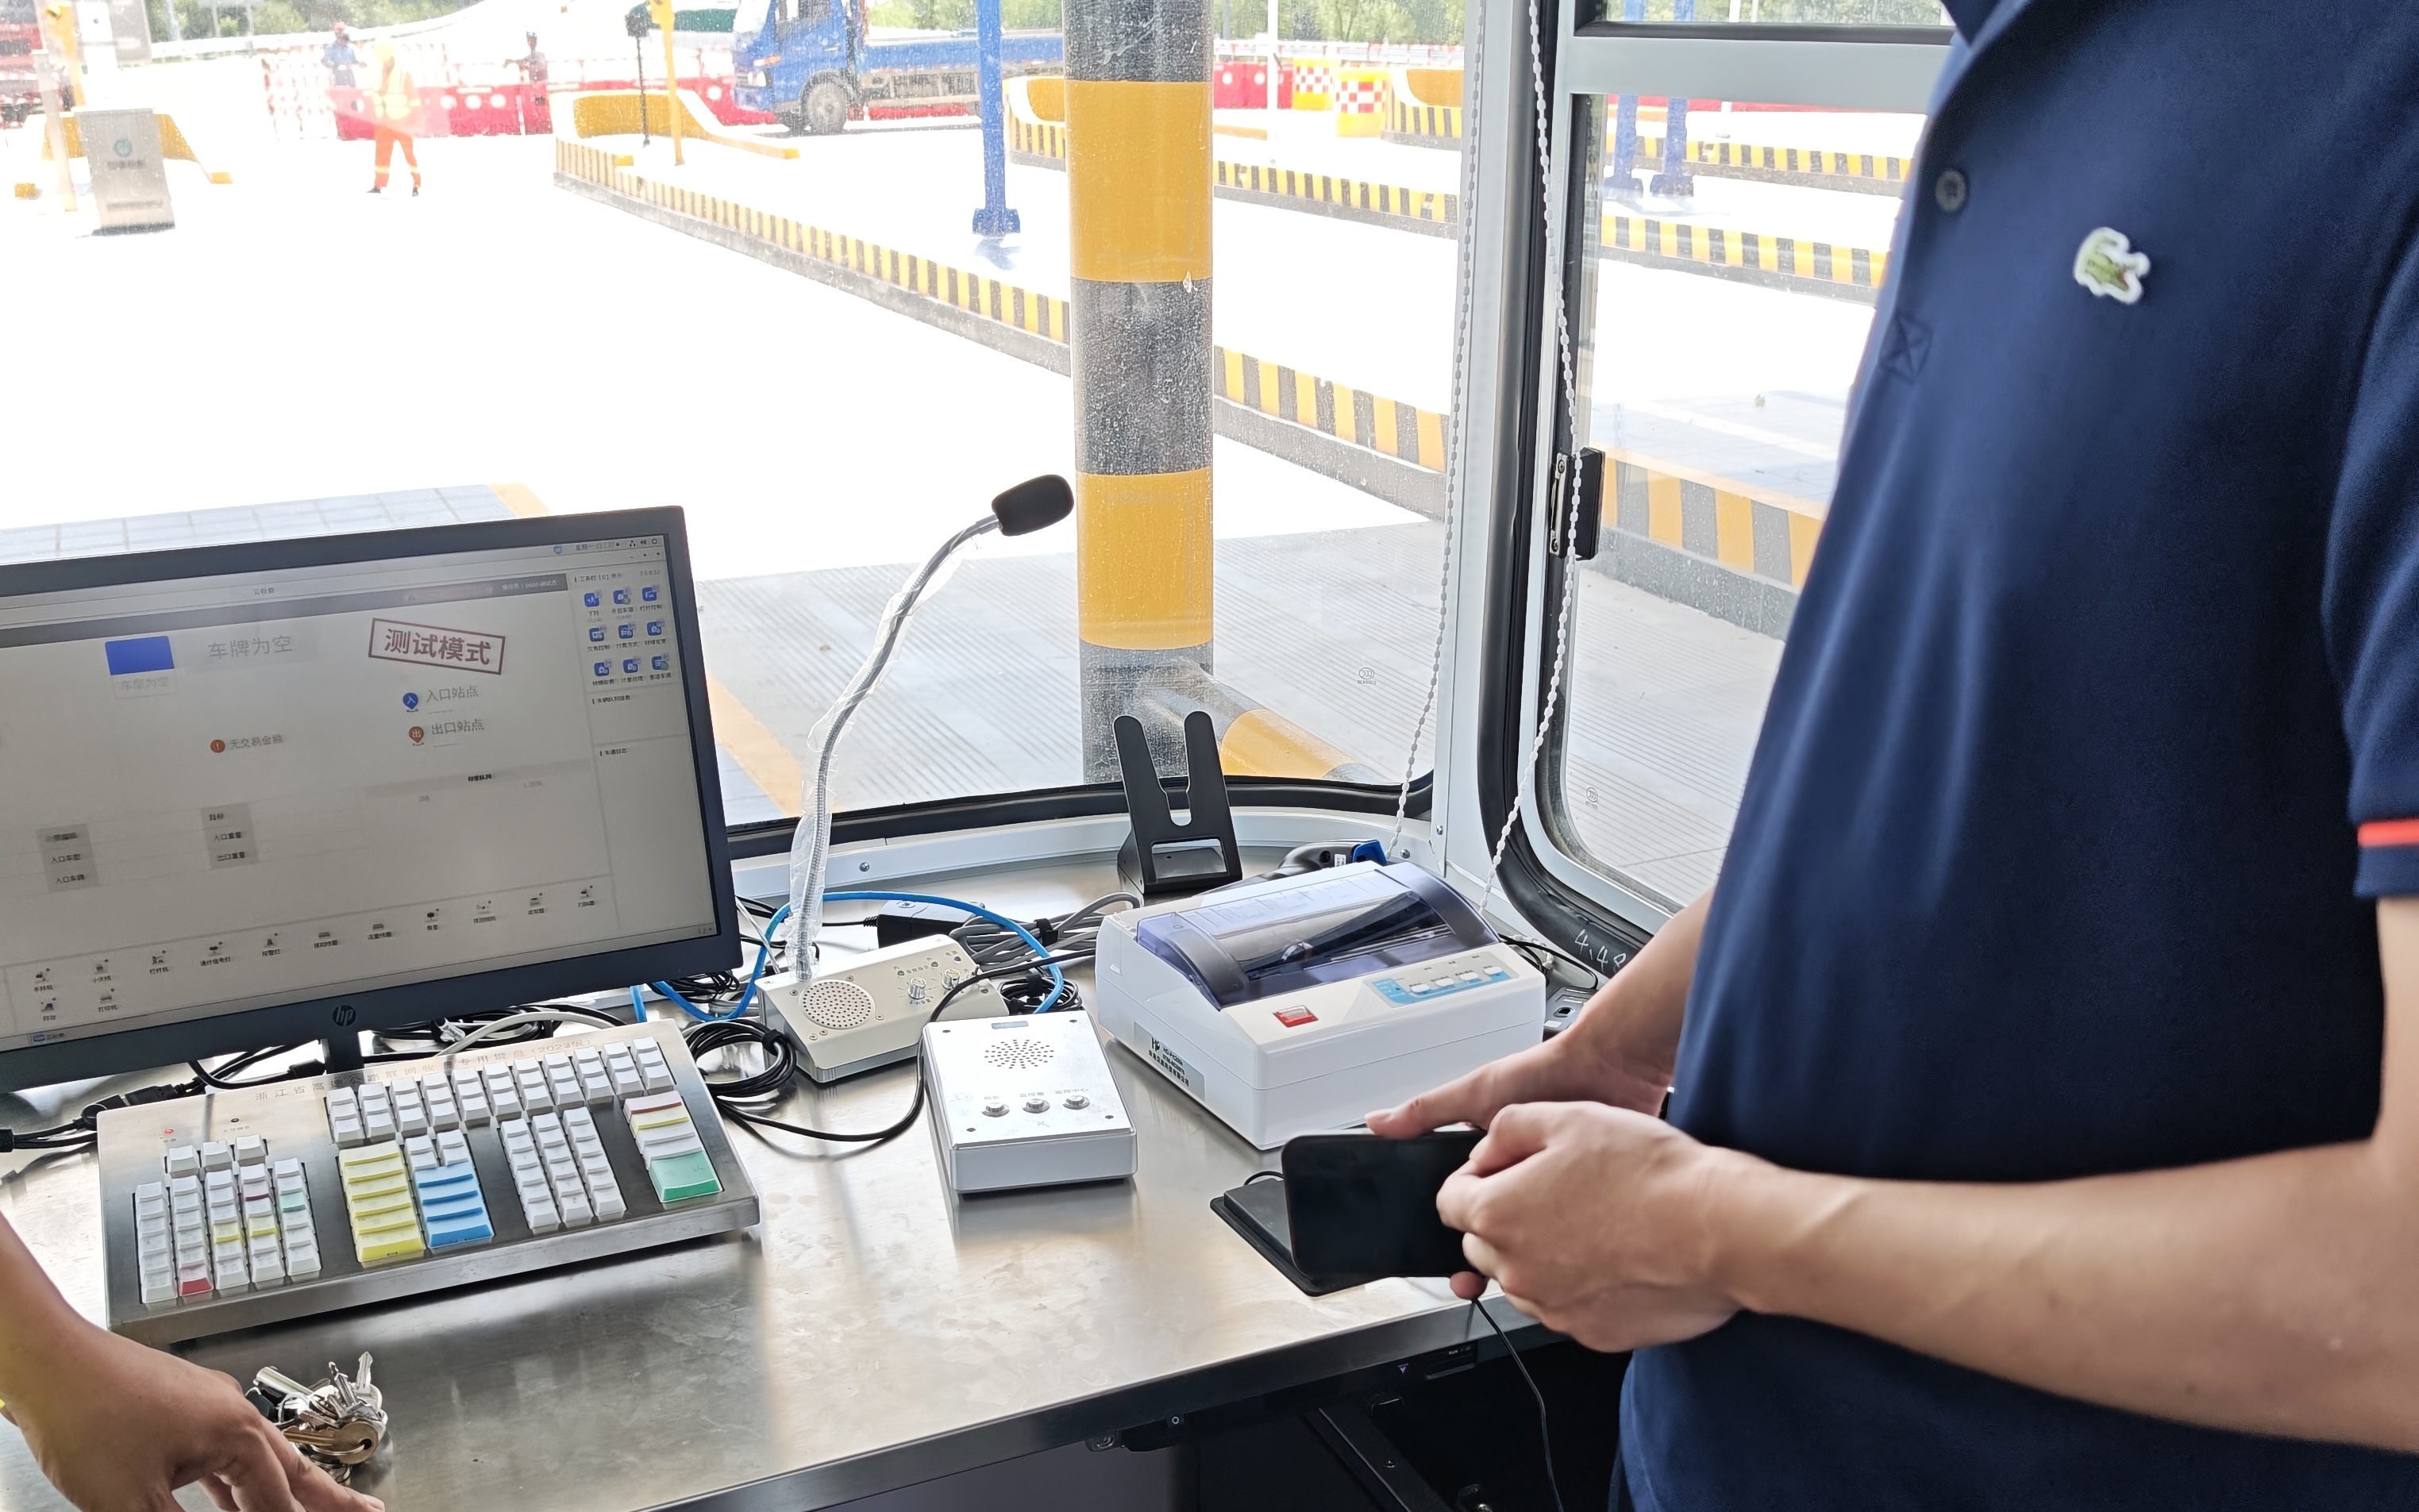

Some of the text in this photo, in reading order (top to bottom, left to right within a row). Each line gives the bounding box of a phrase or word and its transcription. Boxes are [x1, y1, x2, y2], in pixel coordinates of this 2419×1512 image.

[208, 635, 293, 660] 车牌为空
[384, 628, 492, 666] 测试模式
[426, 686, 479, 703] 入口站点
[432, 718, 484, 735] 出口站点
[229, 733, 284, 750] 无交易金额
